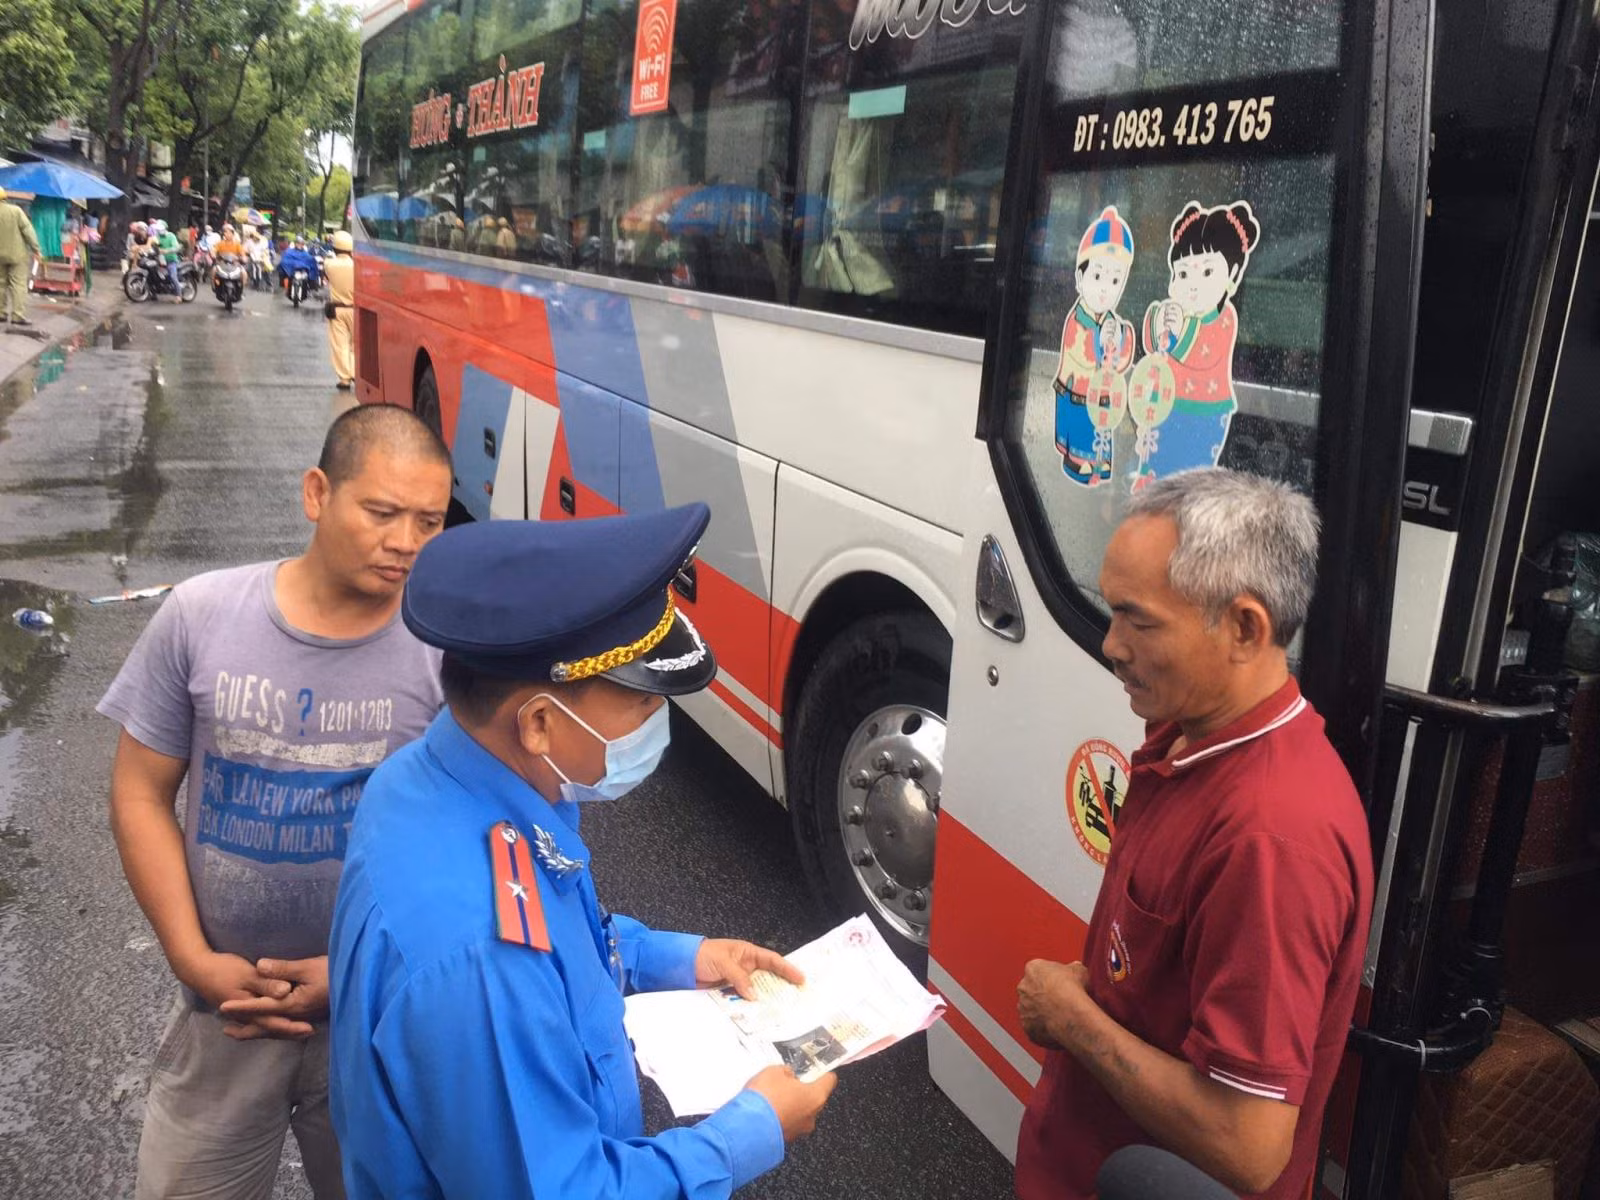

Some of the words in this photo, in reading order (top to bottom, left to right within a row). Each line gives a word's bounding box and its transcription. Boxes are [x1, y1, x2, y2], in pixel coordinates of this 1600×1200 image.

[467, 53, 545, 138] THÀNH
[640, 83, 658, 101] FREE
[1172, 102, 1218, 146] 413
[1223, 96, 1275, 143] 765
[215, 671, 286, 733] GUESS
[291, 787, 336, 815] YORK
[221, 812, 275, 851] LONDON
[279, 824, 335, 853] MILAN
